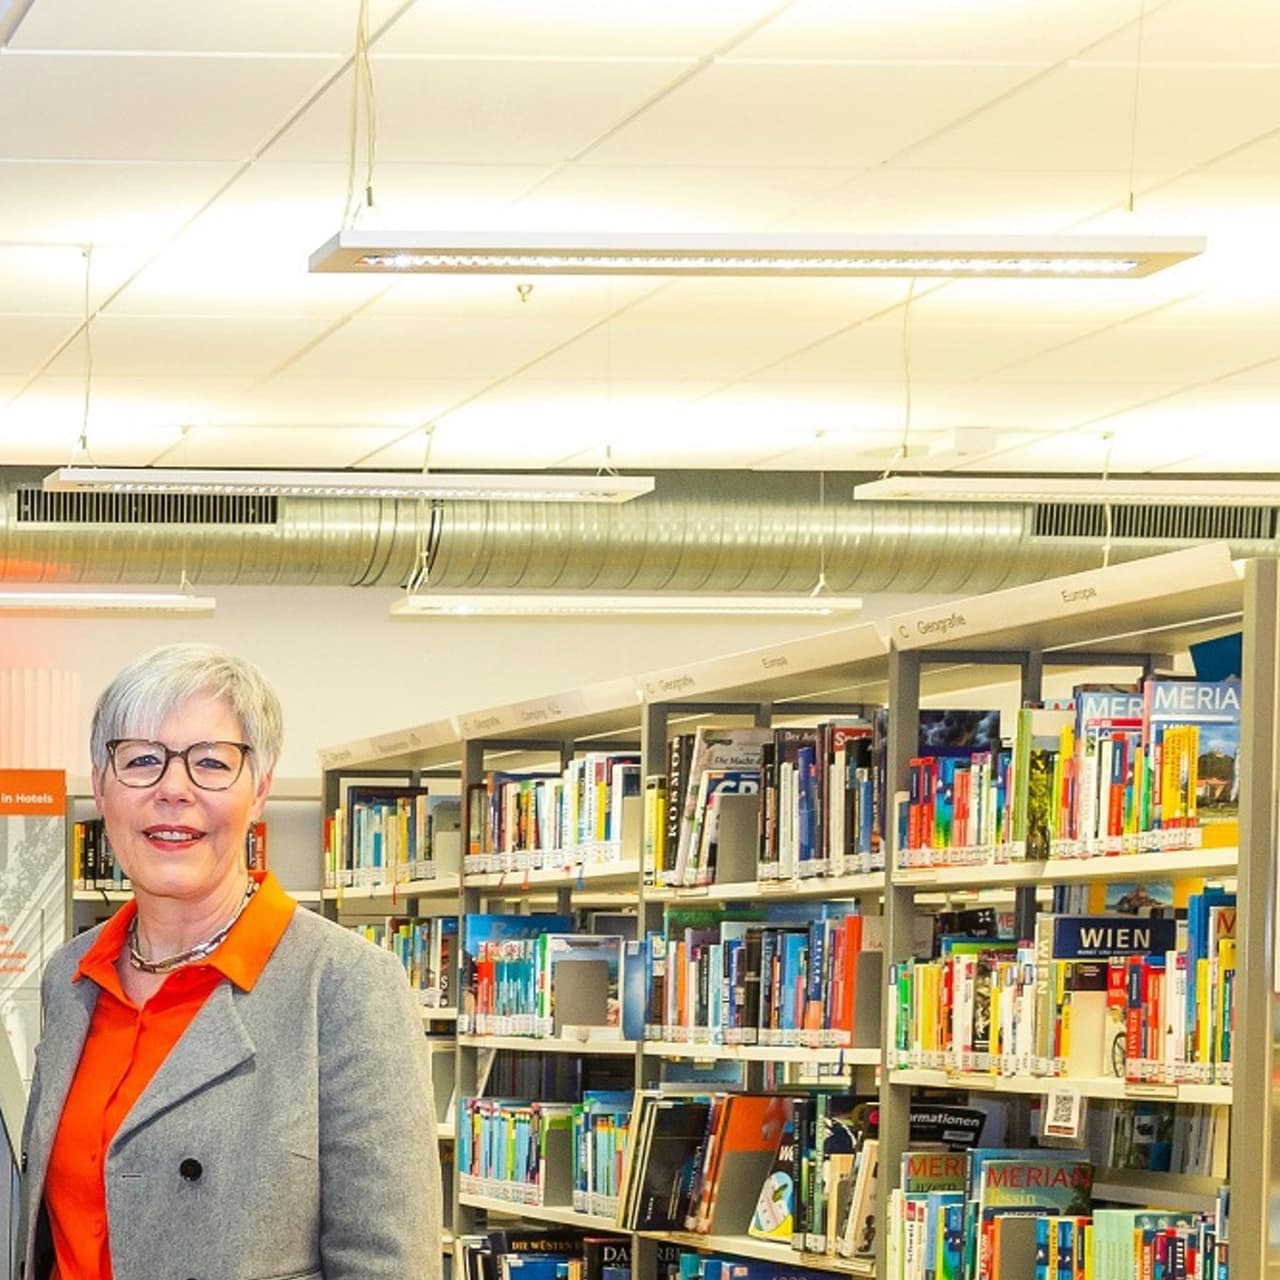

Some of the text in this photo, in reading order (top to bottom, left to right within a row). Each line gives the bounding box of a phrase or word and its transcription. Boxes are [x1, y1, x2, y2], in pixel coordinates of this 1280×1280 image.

[1060, 586, 1098, 604] Europa
[898, 613, 967, 639] C Geografie
[668, 736, 681, 837] KOSMOS
[1, 793, 13, 804] in
[16, 793, 54, 804] Hotels
[1079, 927, 1152, 949] WIEN
[1036, 937, 1050, 996] WIEN
[988, 1166, 1090, 1189] MERIAN
